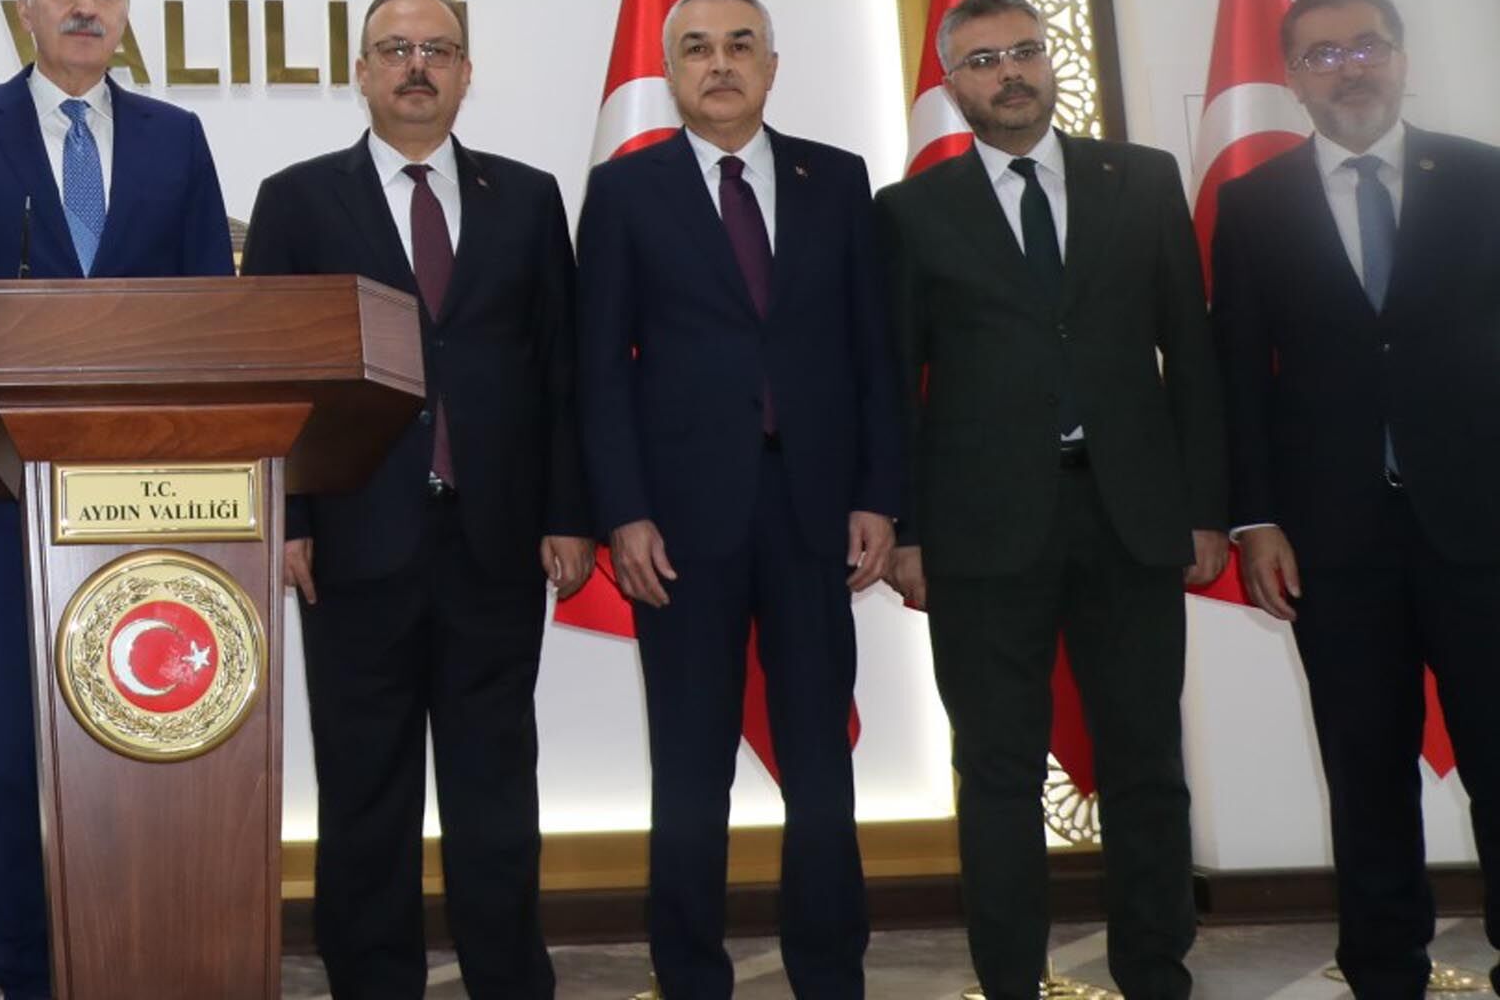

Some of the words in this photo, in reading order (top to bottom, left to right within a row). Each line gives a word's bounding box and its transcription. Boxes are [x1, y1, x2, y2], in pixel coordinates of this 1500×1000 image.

[140, 481, 177, 497] T.C.
[79, 505, 140, 521] AYDIN
[149, 500, 239, 520] VALİLİĞİ
